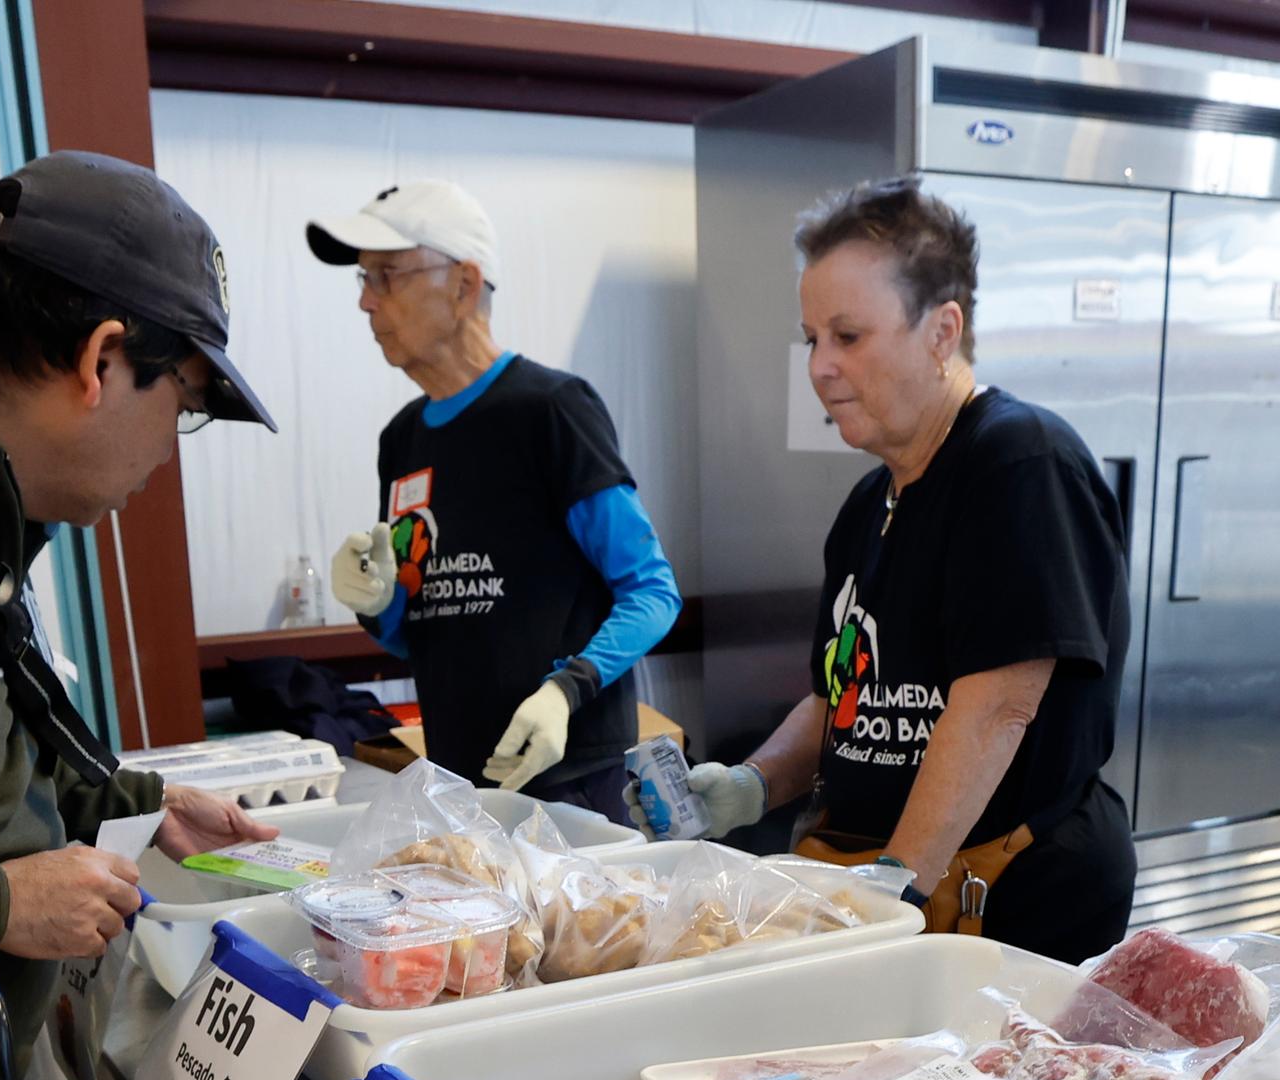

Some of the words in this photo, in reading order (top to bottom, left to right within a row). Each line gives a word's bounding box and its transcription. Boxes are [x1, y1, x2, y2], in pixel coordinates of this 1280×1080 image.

[425, 552, 495, 577] ALAMEDA
[455, 577, 505, 598] BANK
[464, 600, 495, 615] 1977
[857, 683, 946, 710] ALMEDA
[898, 716, 935, 743] BA
[196, 976, 256, 1057] Fish
